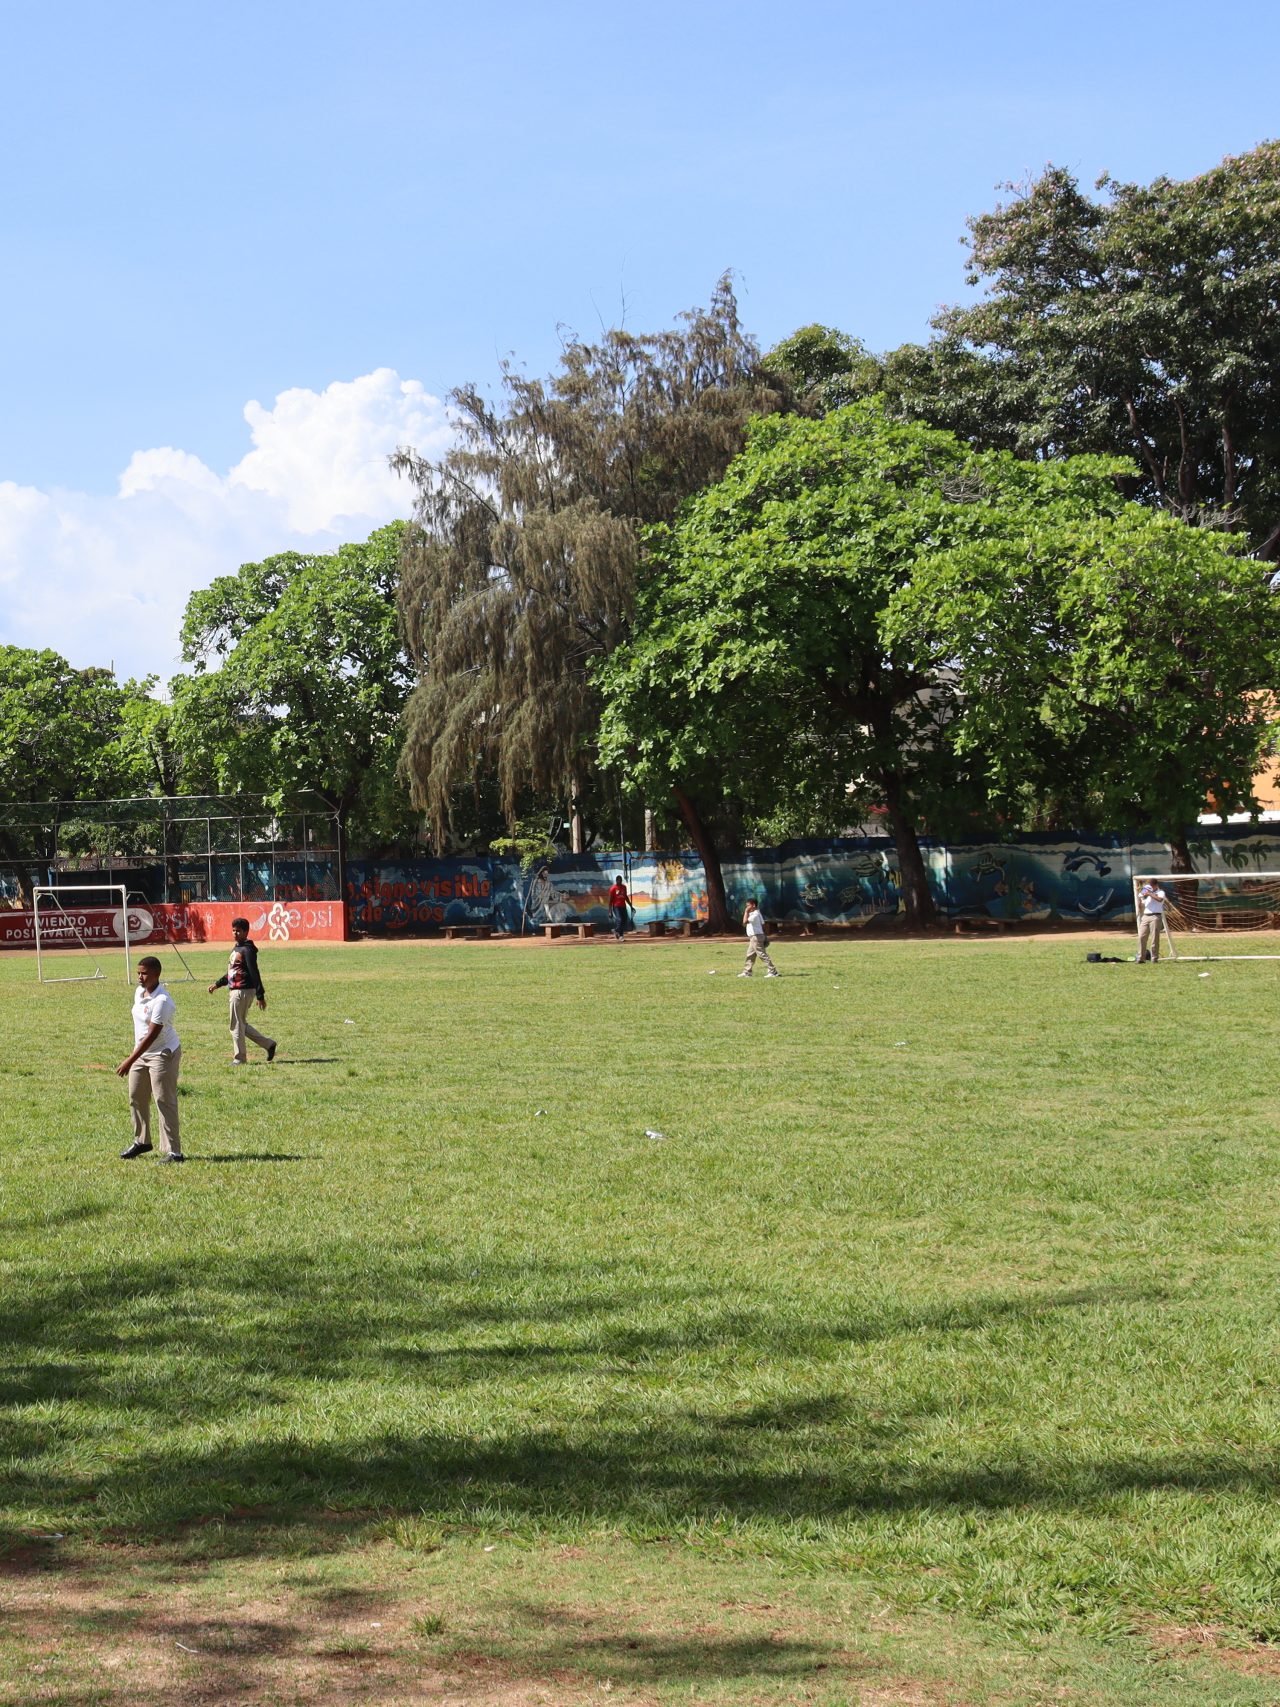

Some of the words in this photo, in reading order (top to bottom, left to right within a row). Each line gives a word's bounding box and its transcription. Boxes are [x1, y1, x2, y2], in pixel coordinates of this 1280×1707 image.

[360, 876, 418, 906] signo
[420, 874, 491, 897] visible
[361, 902, 382, 922] de
[6, 925, 110, 939] POSIIVAMENTE
